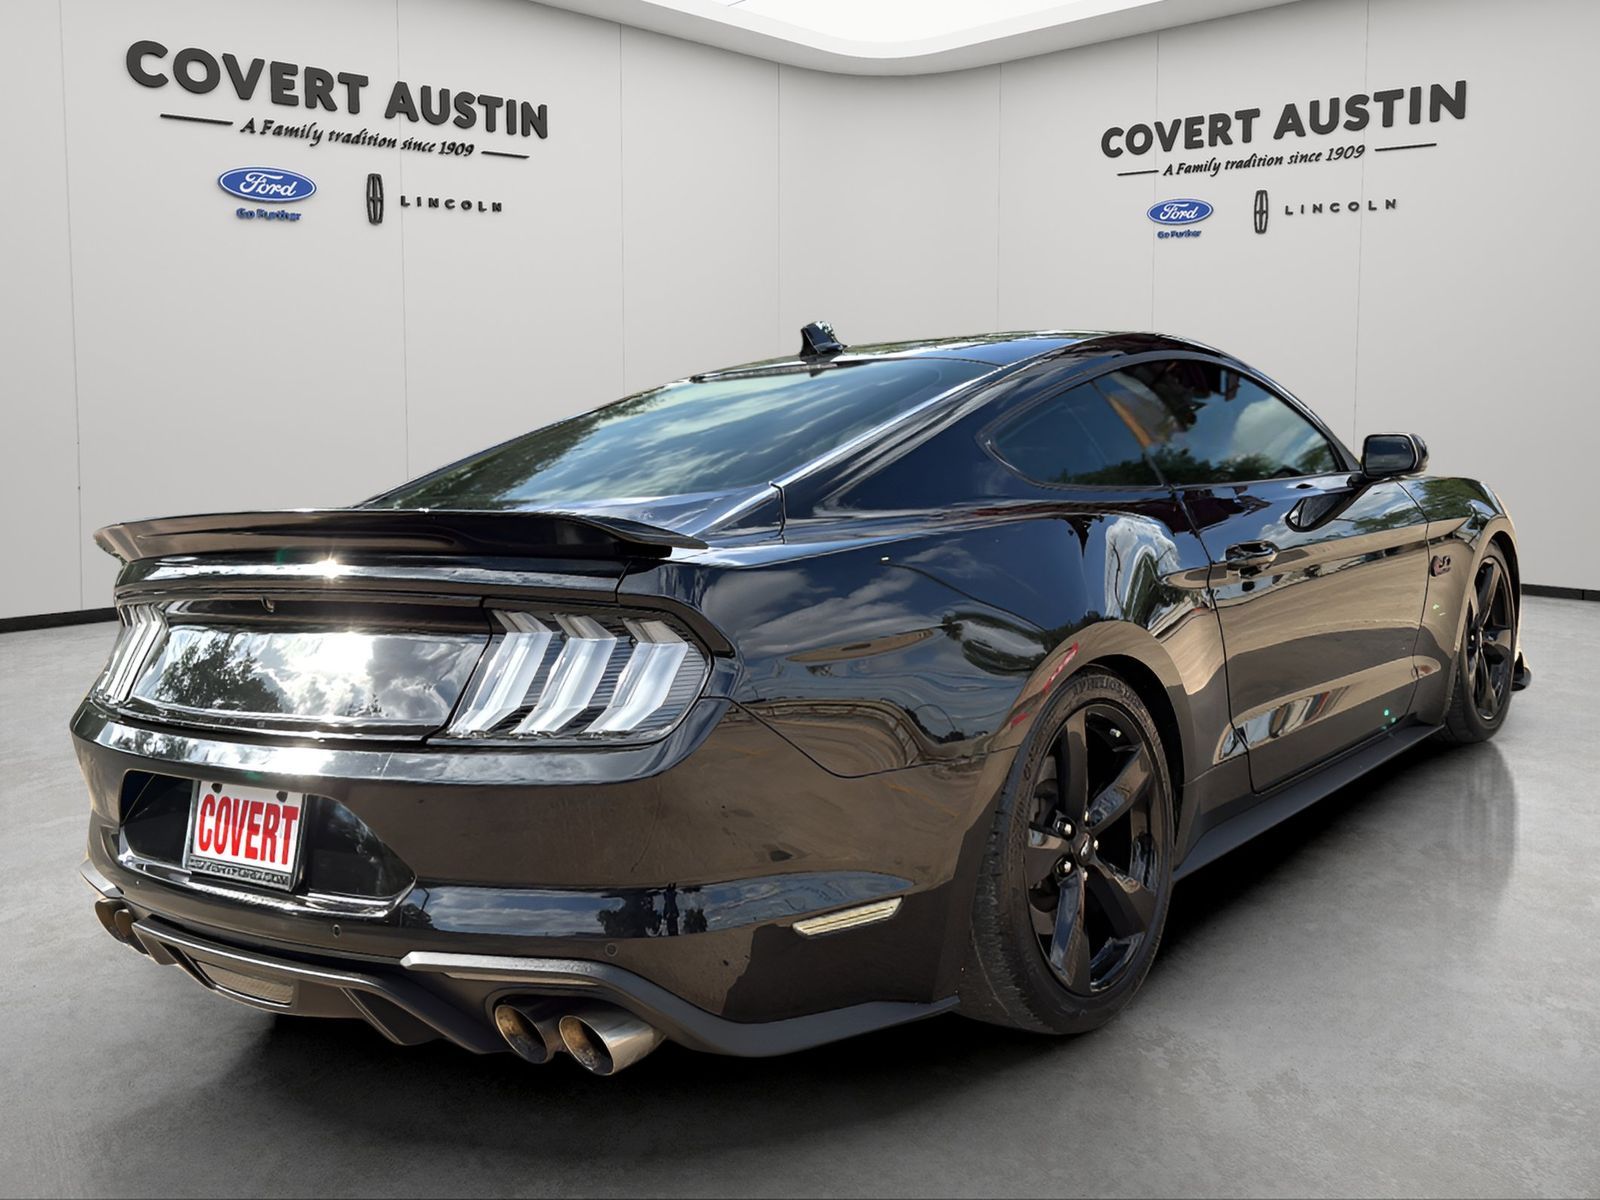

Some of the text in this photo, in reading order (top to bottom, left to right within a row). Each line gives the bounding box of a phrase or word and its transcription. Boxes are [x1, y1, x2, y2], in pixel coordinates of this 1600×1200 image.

[125, 39, 548, 140] COVERT AUSTIN
[1100, 79, 1467, 159] COVERT AUSTIN
[239, 117, 475, 158] A Family tradition since 1909
[1162, 144, 1366, 178] A Family tradition since 1909
[239, 171, 298, 197] Ford
[236, 207, 255, 220] Go
[400, 195, 502, 213] LINCOLN
[1159, 202, 1200, 220] Ford
[1284, 198, 1397, 217] LINCOLN
[1157, 230, 1171, 239] Go
[198, 793, 300, 865] COVERT
